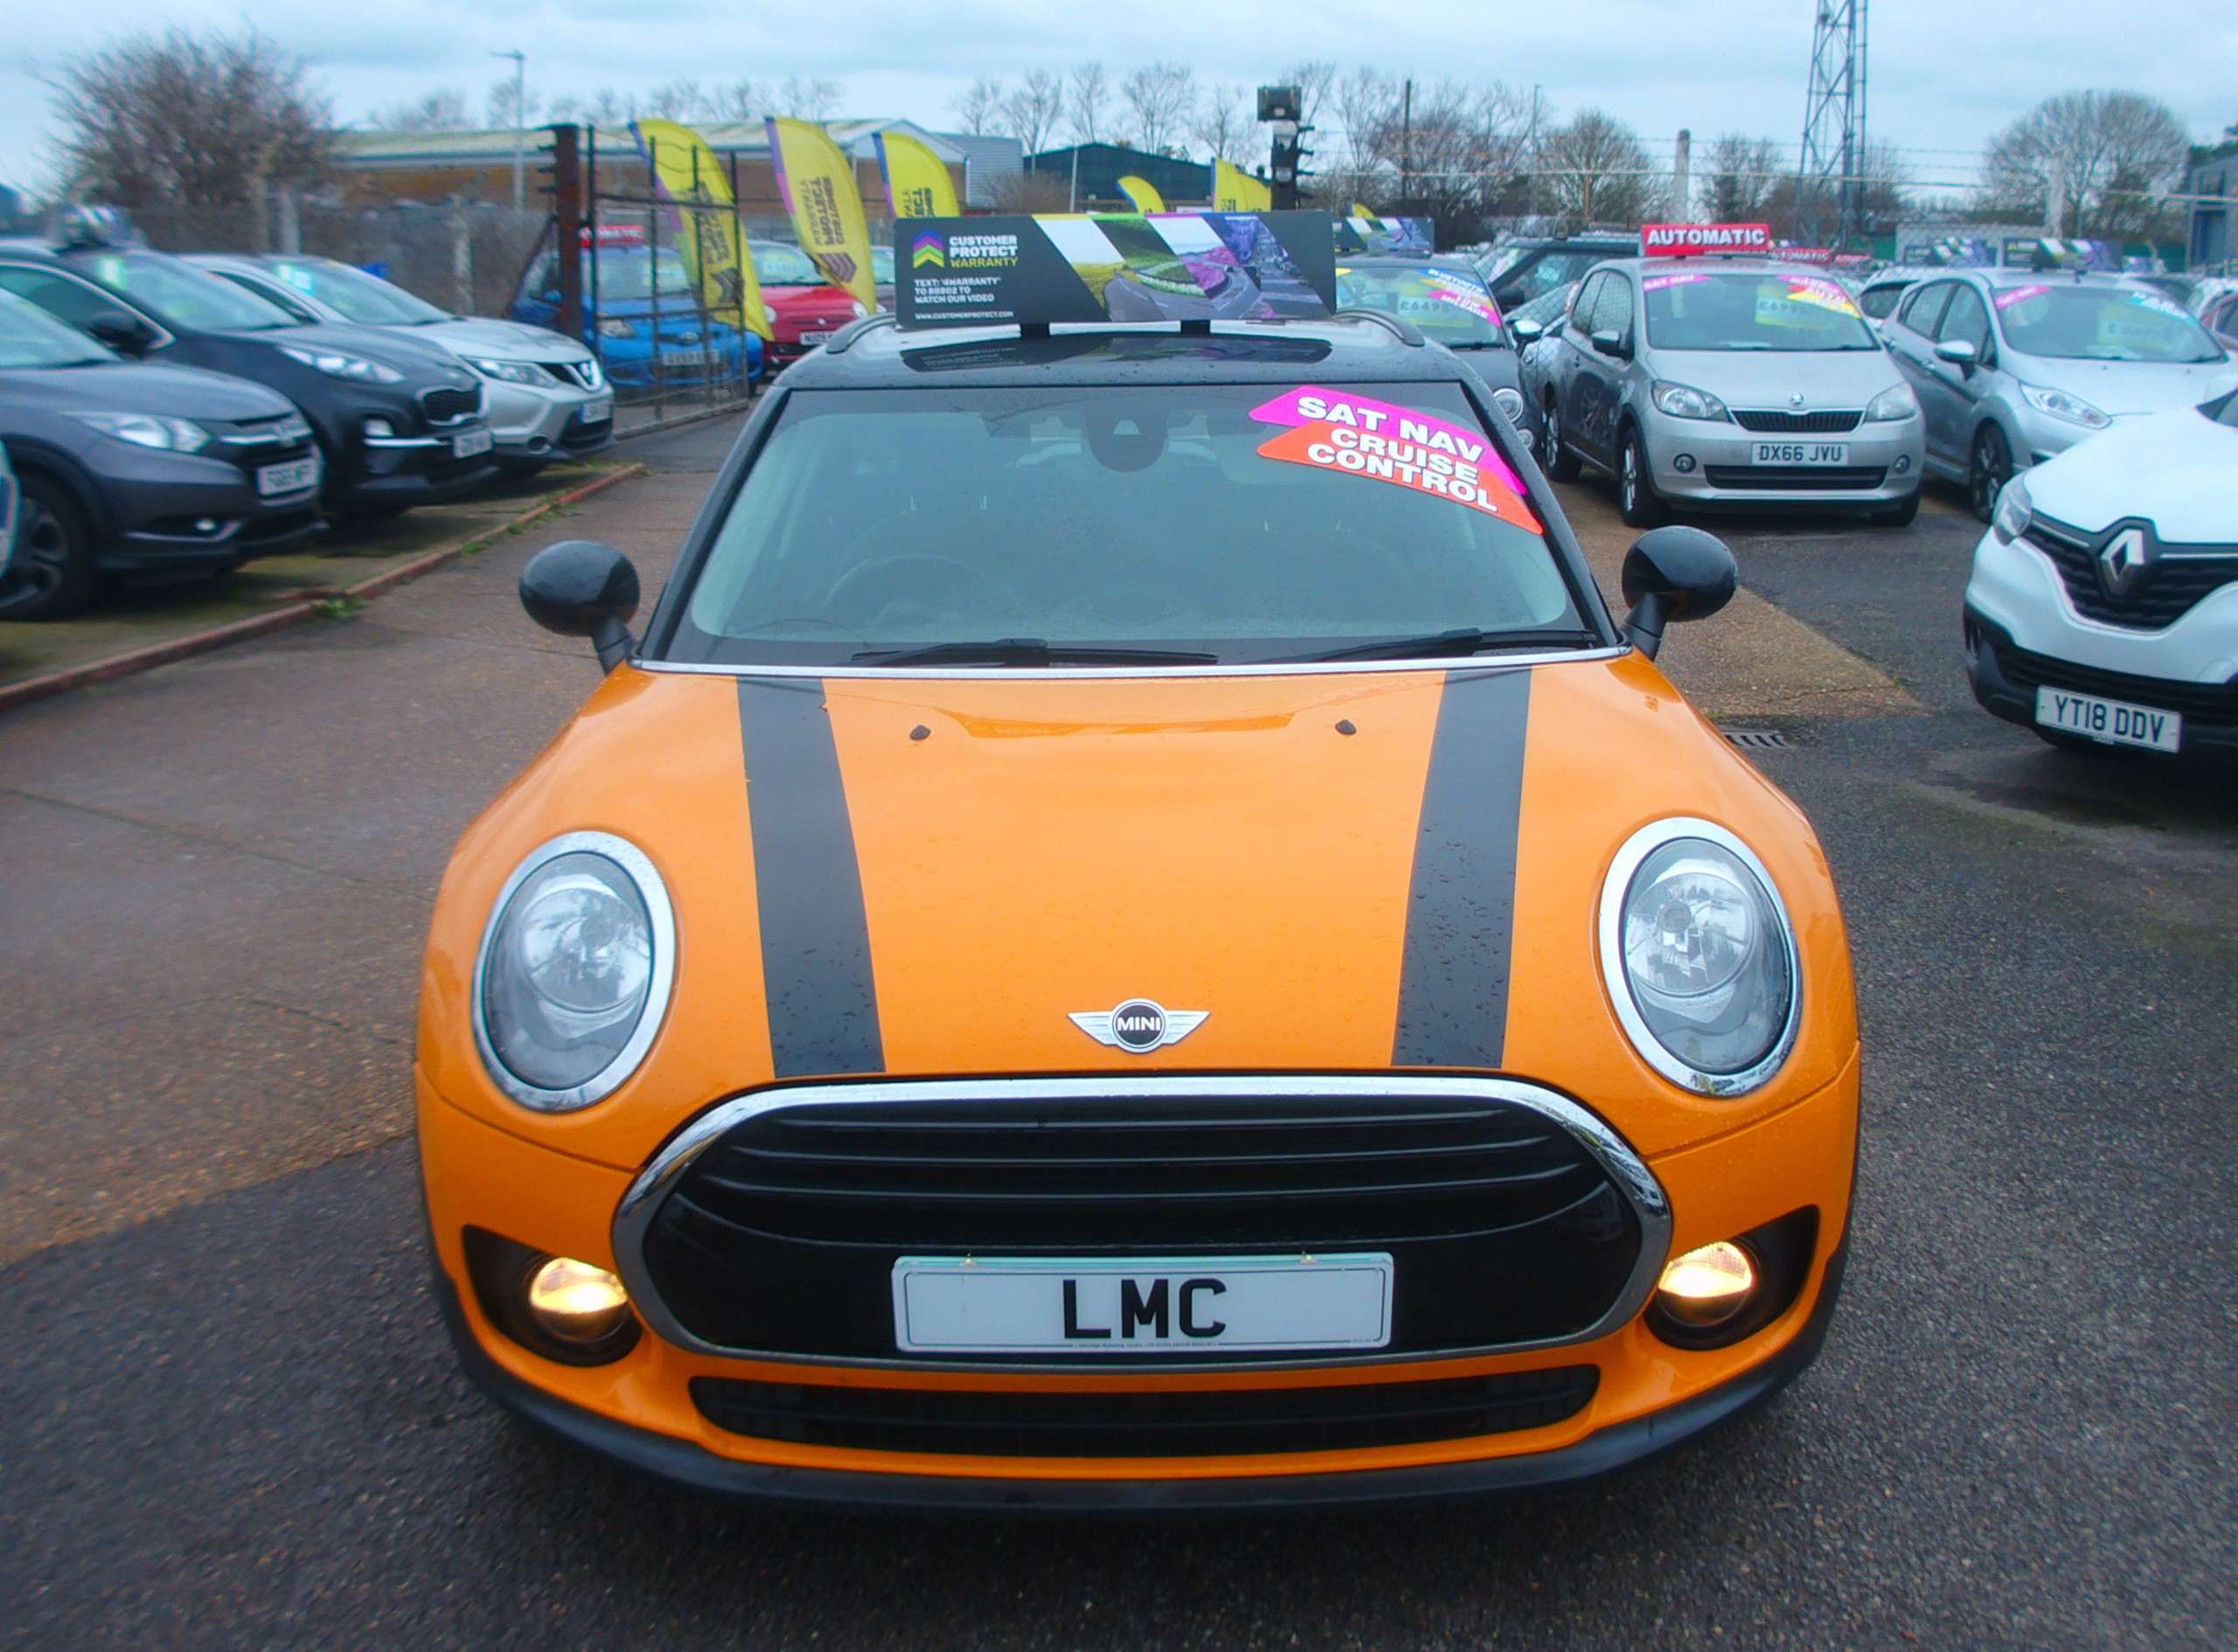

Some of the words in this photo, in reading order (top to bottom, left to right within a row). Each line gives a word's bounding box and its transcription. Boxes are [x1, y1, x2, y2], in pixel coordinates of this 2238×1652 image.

[949, 235, 1018, 246] CUSTOMER
[1647, 228, 1766, 246] AUTOMATIC
[949, 246, 1018, 258] PROTECT
[950, 257, 1018, 267] WARRANTY
[914, 278, 940, 288] TEXT:
[947, 295, 966, 303] OUR
[967, 294, 995, 302] VIDEO
[914, 311, 1014, 320] WWW.CUSTOMERPROTECT.COM
[1296, 397, 1387, 431] SAT
[1399, 418, 1484, 462] NAV
[1331, 428, 1479, 486] CRUISE
[1759, 445, 1804, 462] DX66
[1810, 446, 1841, 462] JVU
[1307, 443, 1498, 512] CONTROL
[2055, 695, 2107, 731] YT18
[2114, 707, 2165, 743] DDV
[1116, 1017, 1161, 1031] MINI
[1062, 1278, 1227, 1338] LMC
